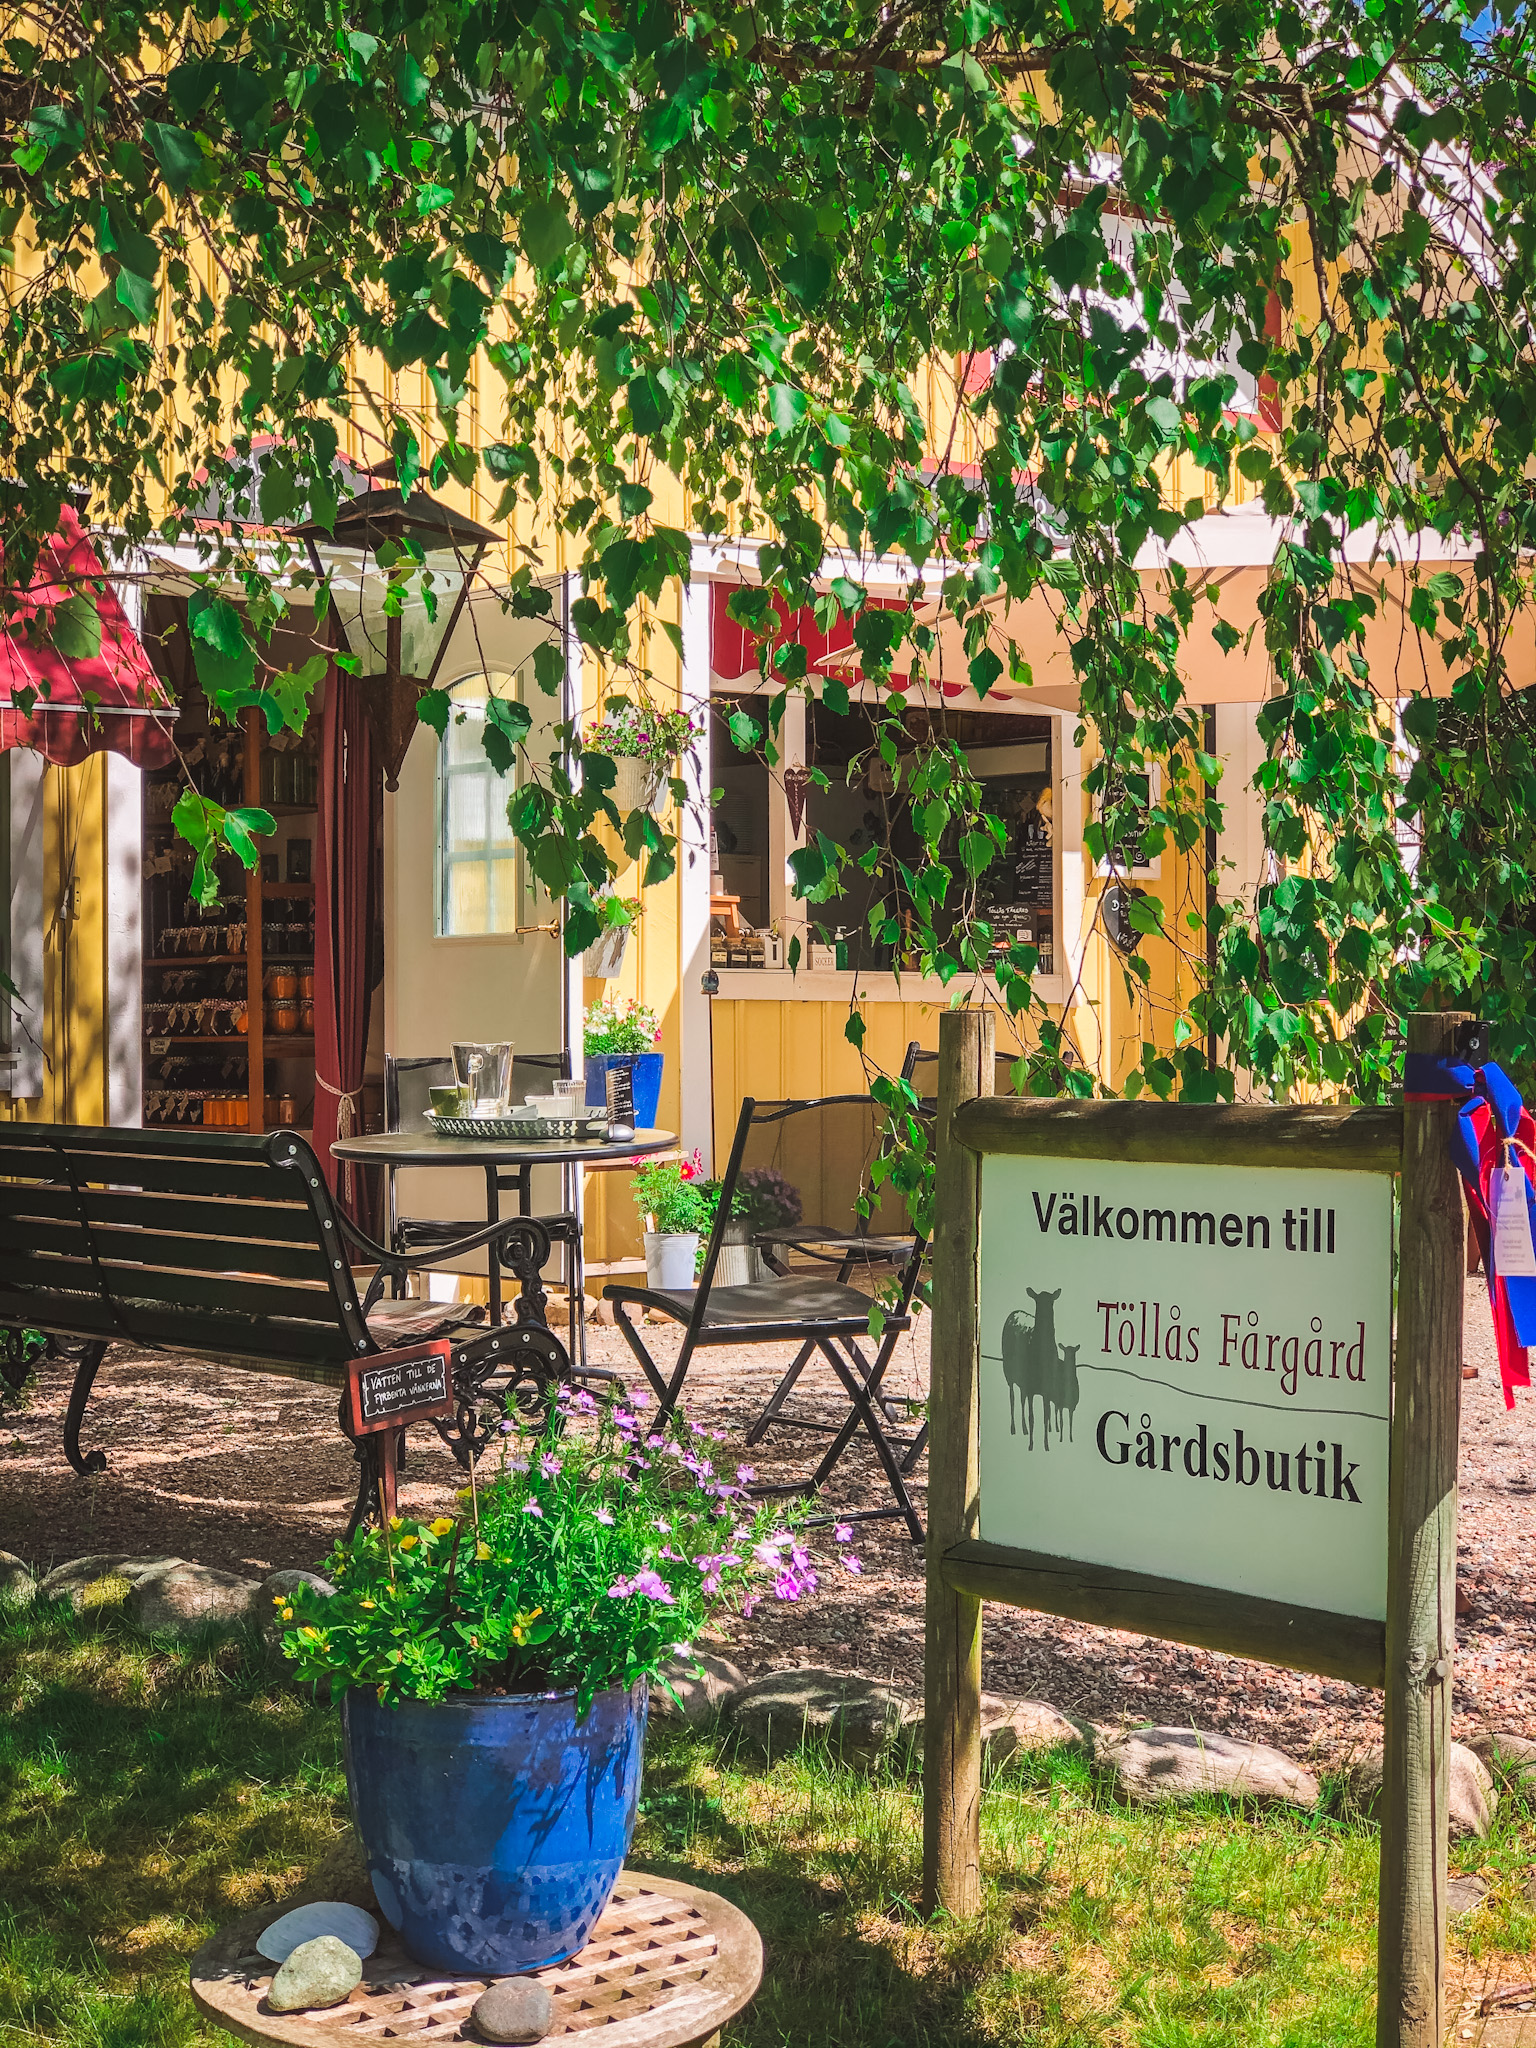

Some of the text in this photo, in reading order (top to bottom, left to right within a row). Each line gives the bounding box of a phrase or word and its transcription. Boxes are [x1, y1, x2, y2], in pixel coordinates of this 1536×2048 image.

[1031, 1191, 1336, 1254] Välkommen till
[370, 1363, 436, 1390] VATTEN TILL DE
[1096, 1300, 1367, 1396] Töllås Fårgård
[1095, 1409, 1363, 1504] Gårdsbutik
